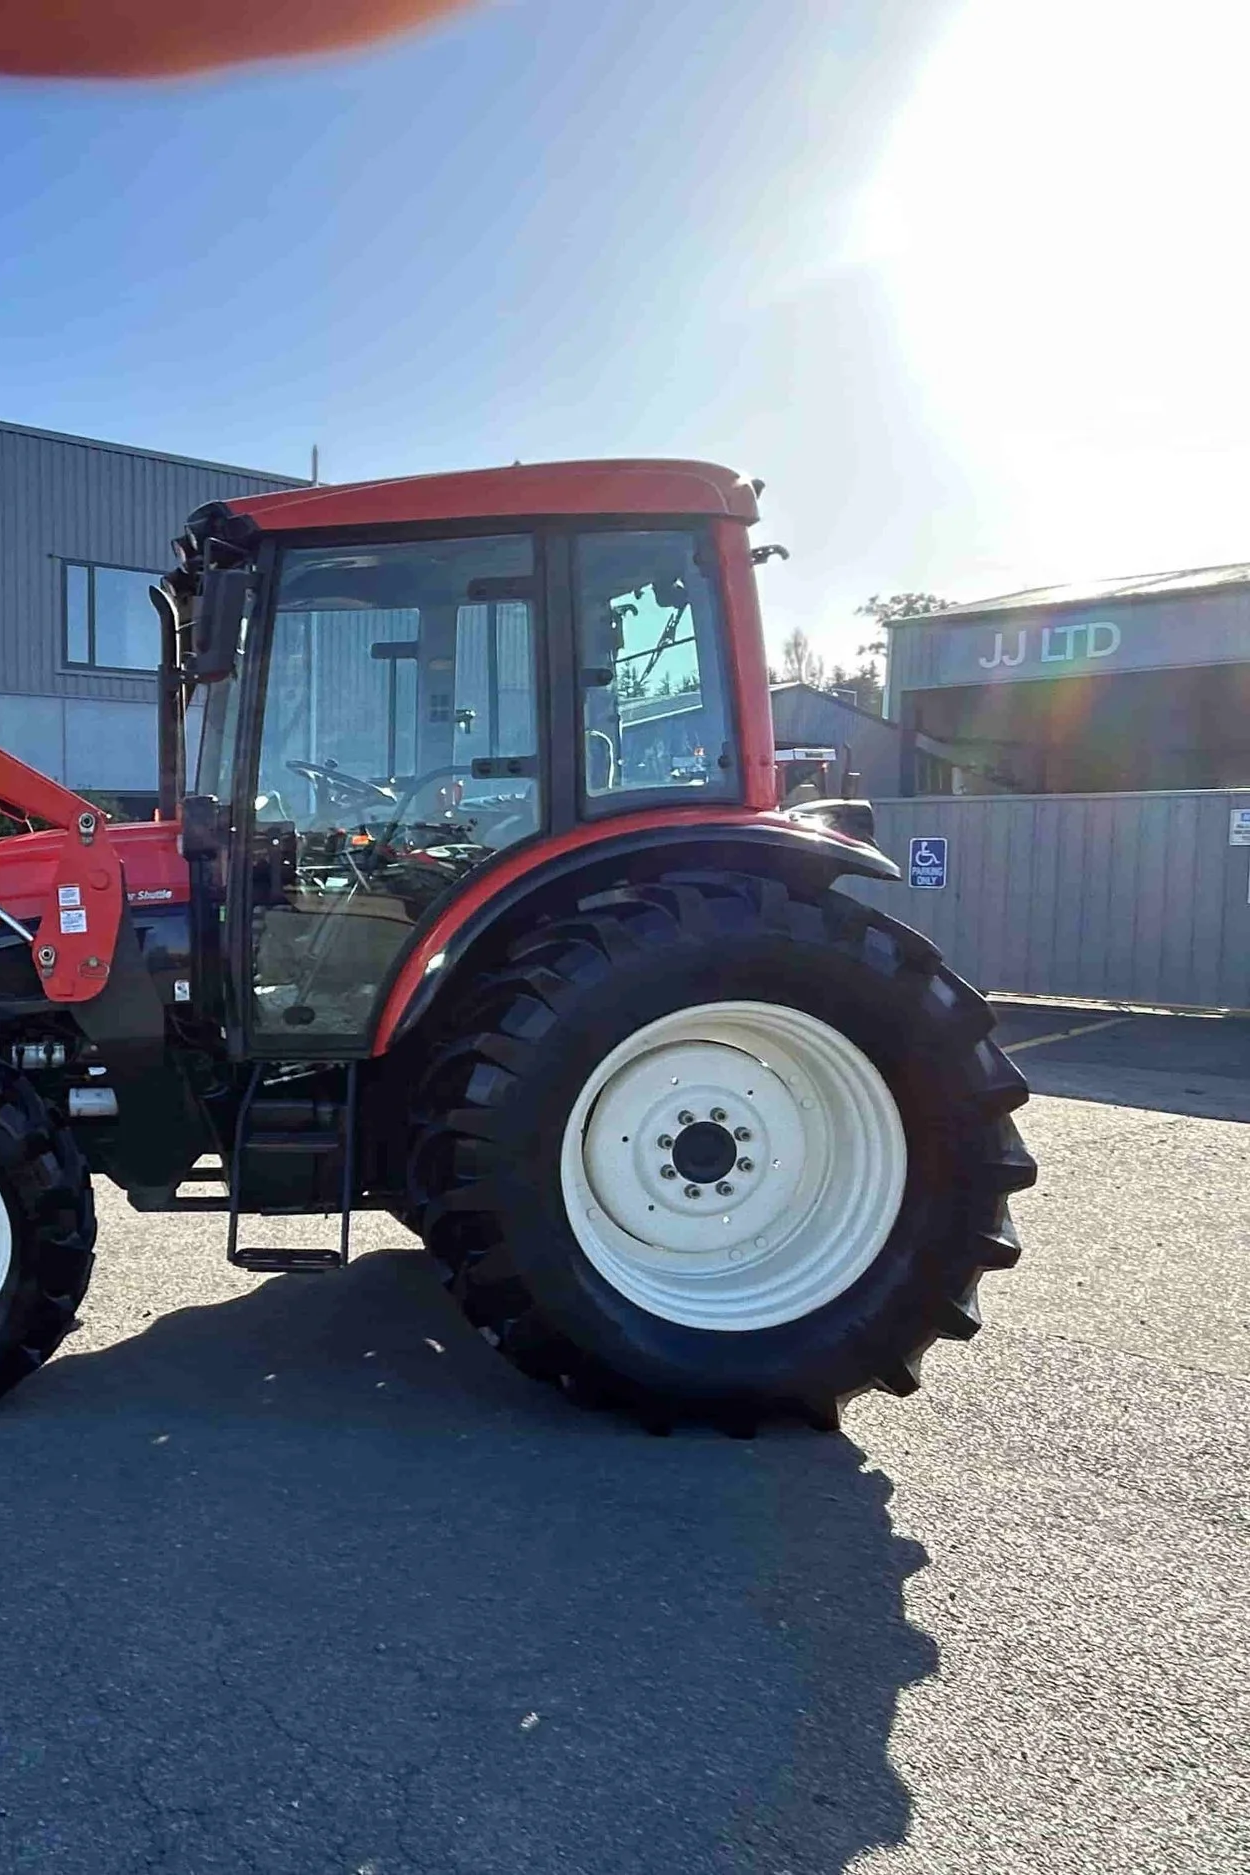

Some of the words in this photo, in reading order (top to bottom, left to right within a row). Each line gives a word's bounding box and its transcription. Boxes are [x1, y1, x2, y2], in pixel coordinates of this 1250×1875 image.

[978, 630, 1026, 669] JJ
[1041, 621, 1121, 663] LTD
[911, 866, 943, 877] PARKING
[917, 876, 938, 885] ONLY
